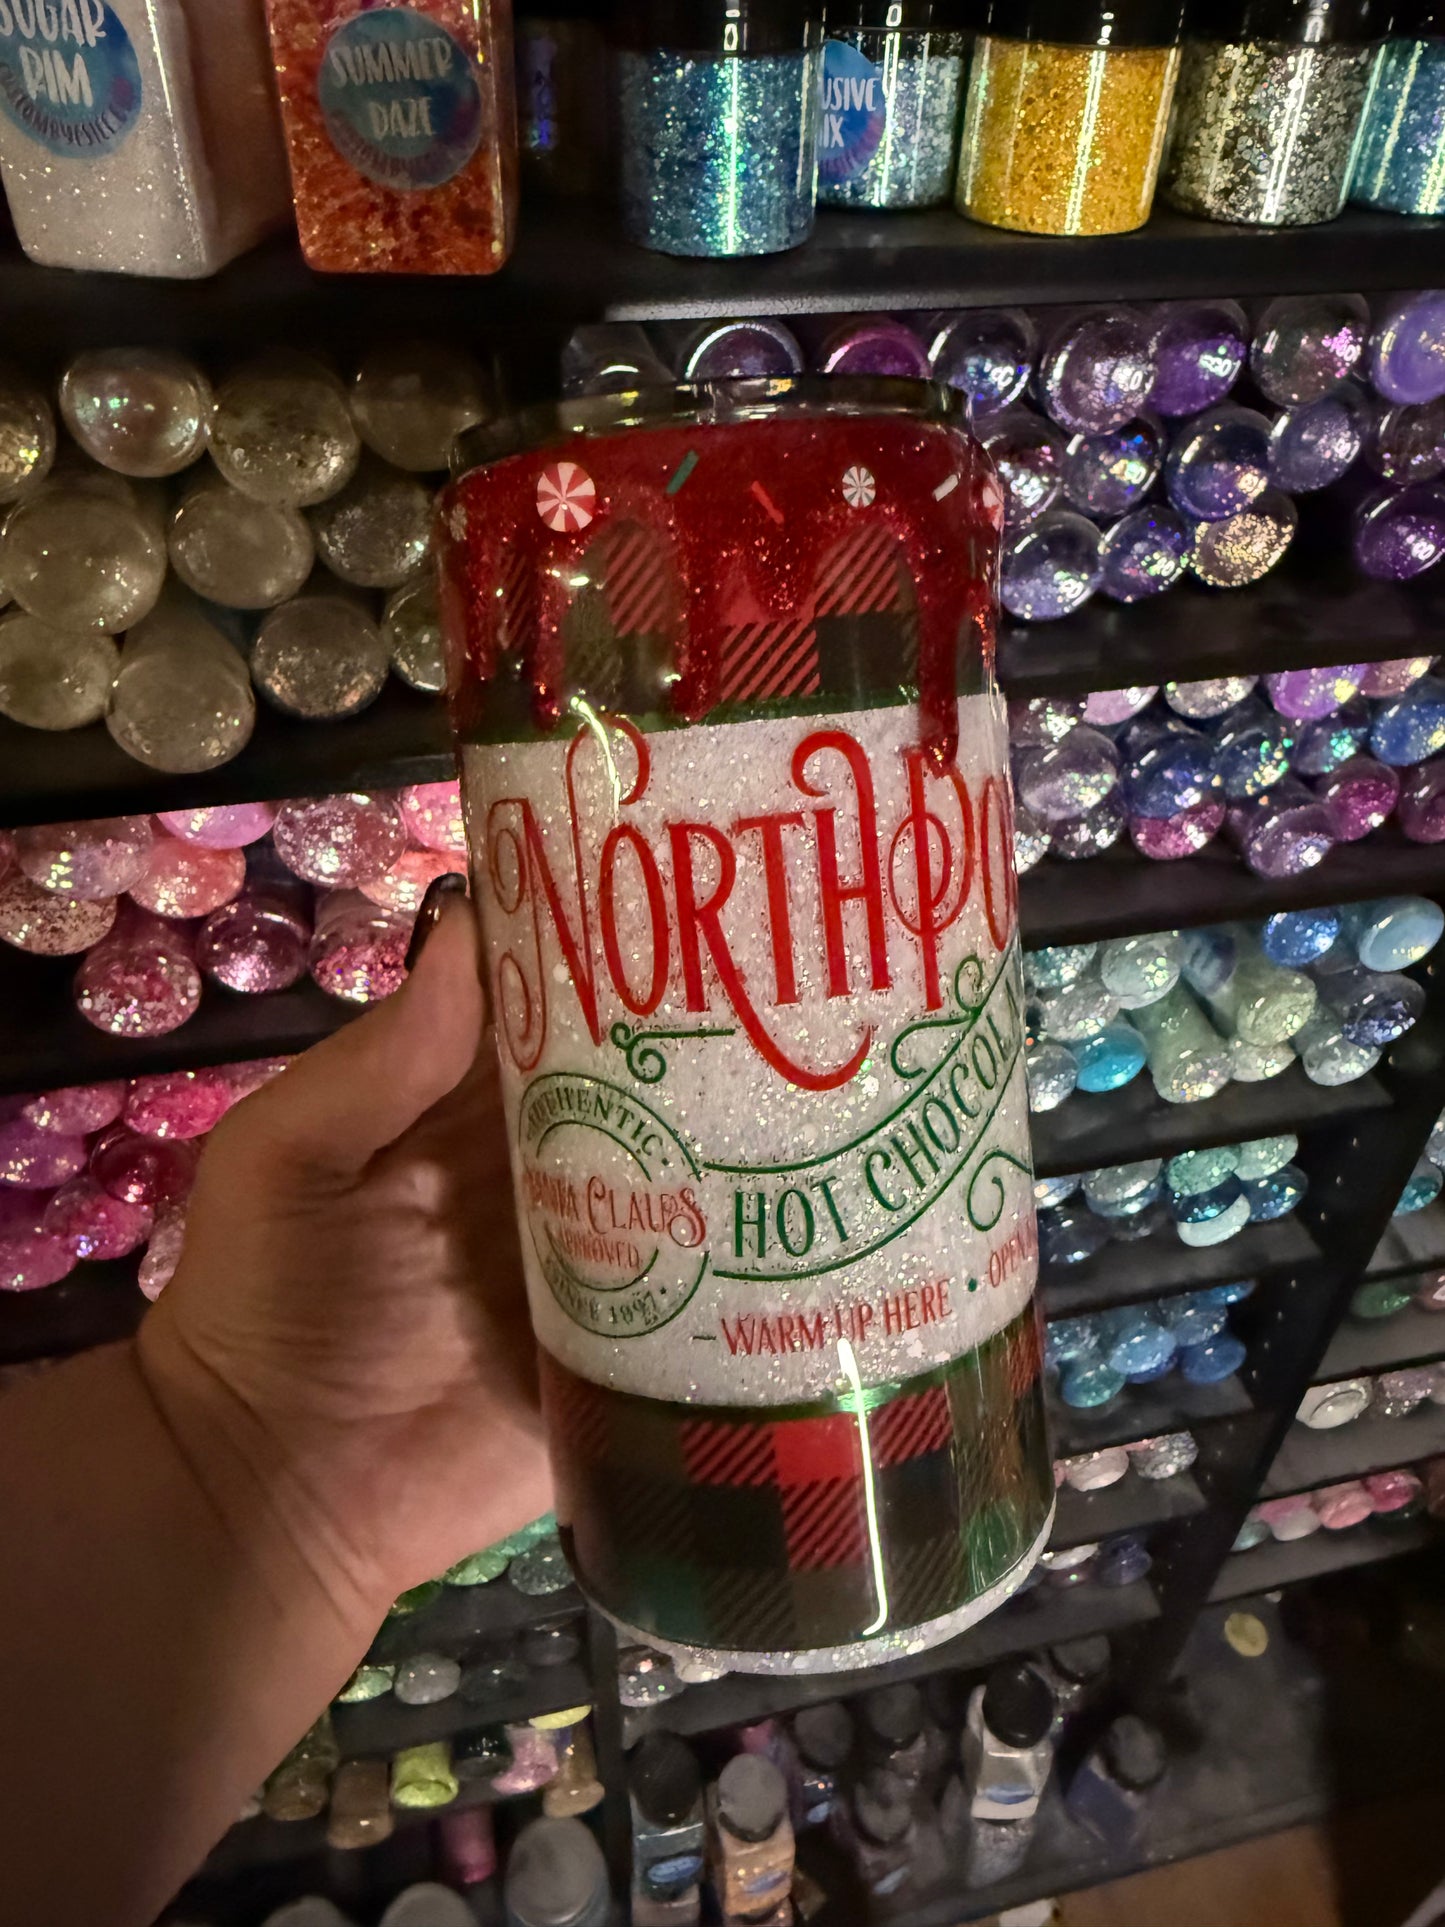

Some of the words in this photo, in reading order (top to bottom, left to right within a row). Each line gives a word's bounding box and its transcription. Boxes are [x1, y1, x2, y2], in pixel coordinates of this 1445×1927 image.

[19, 45, 94, 108] RIM
[328, 37, 453, 89] SUMMER
[368, 97, 438, 141] DAZE
[819, 113, 845, 149] IX
[735, 1175, 850, 1260] HOT
[720, 1311, 826, 1357] WARM
[831, 1300, 874, 1343] UP
[882, 1278, 954, 1337] HERE
